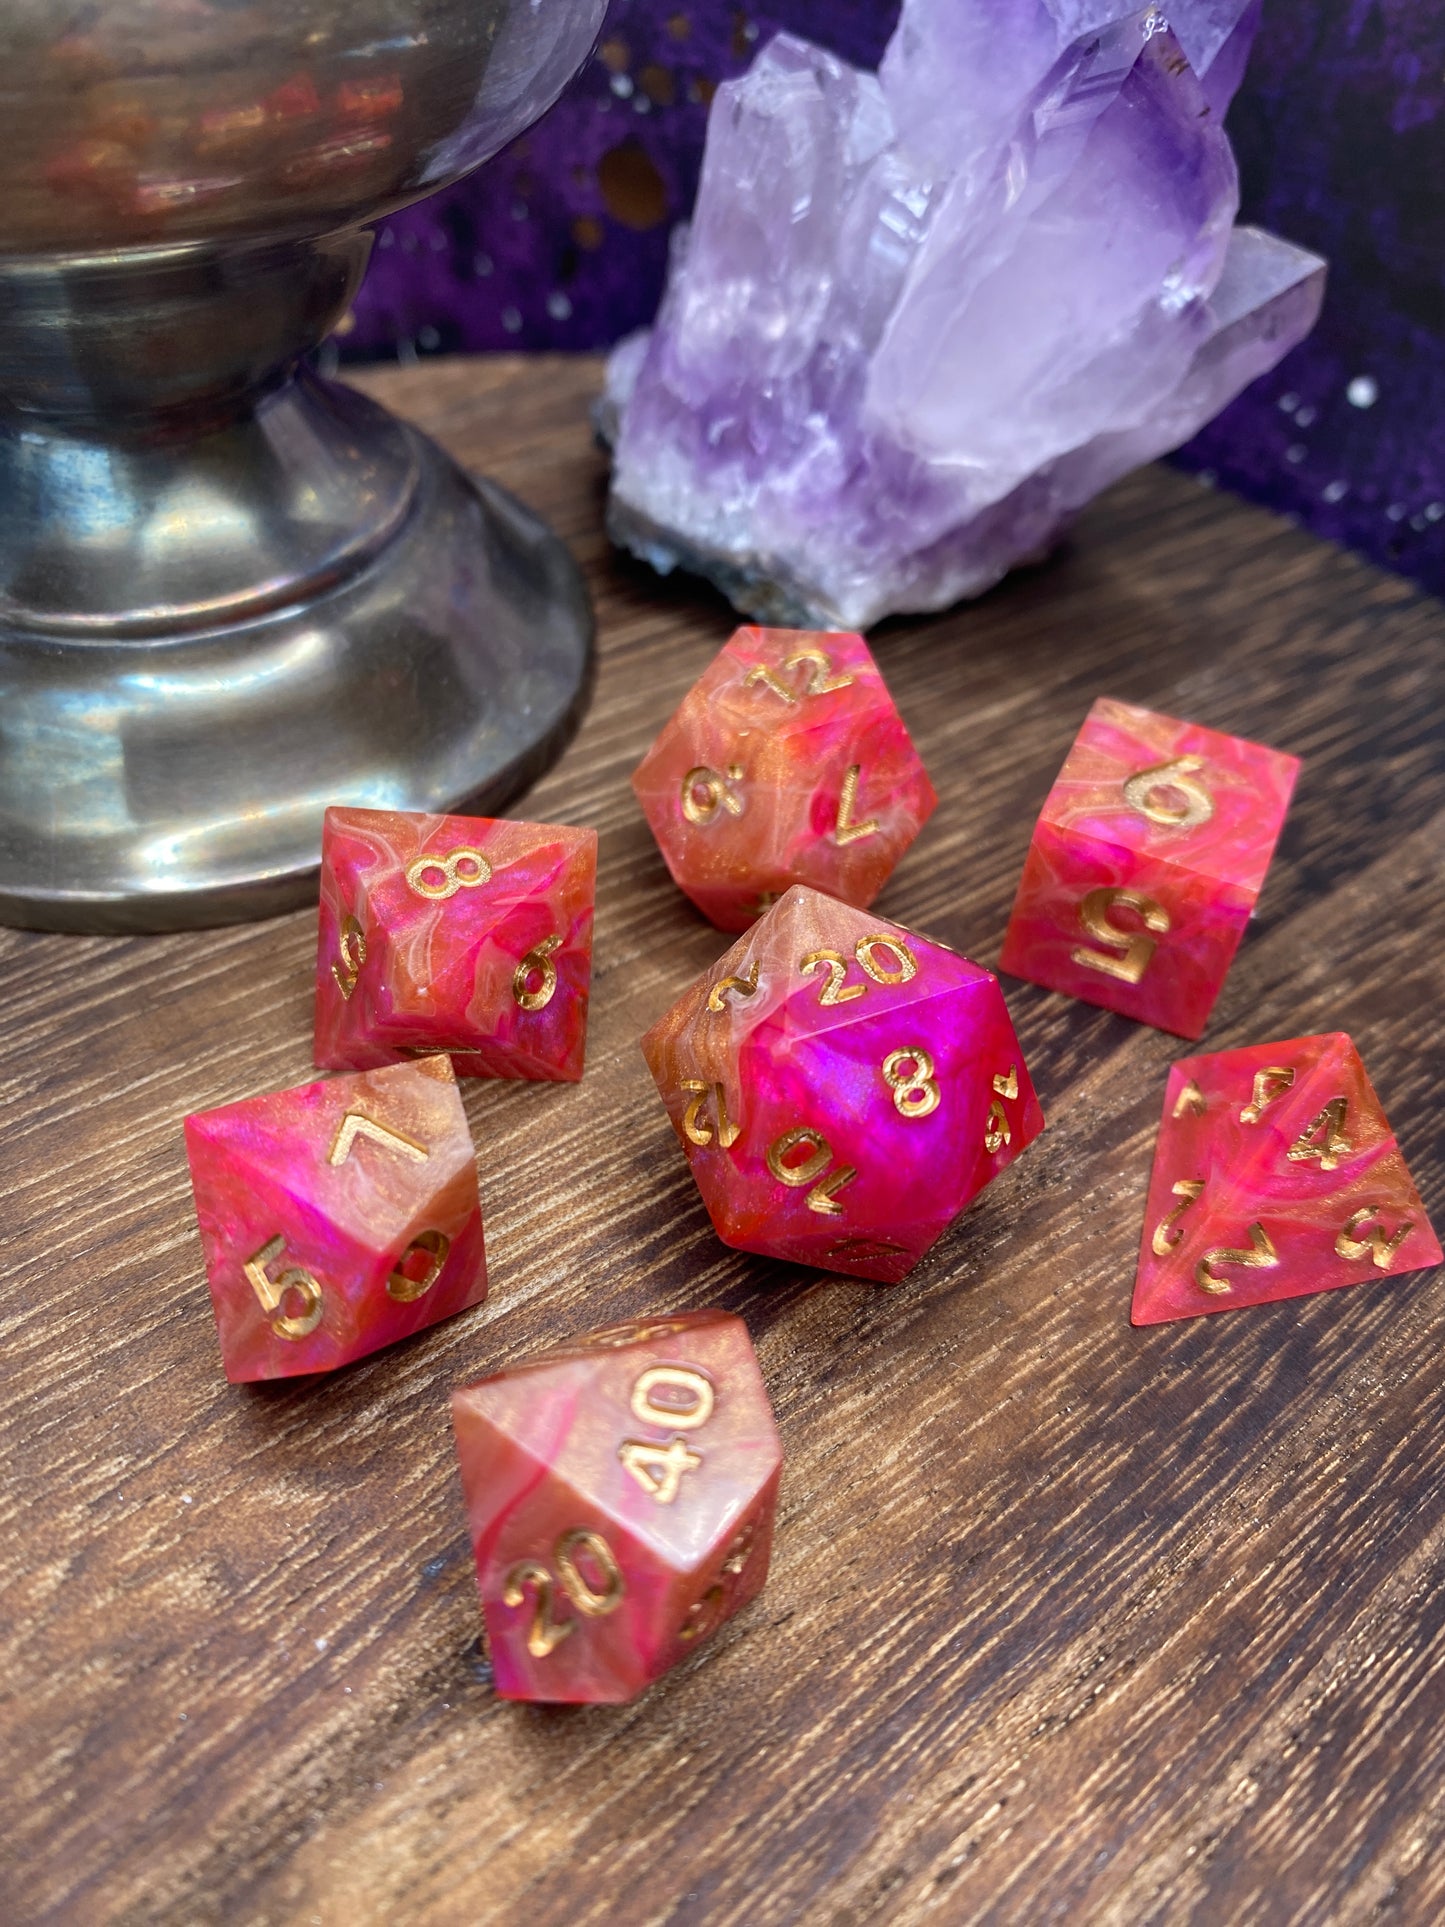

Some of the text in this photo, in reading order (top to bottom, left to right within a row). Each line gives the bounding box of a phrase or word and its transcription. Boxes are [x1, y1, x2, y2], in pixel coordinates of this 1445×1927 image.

[743, 648, 857, 704] 12
[835, 764, 881, 846] 7
[1123, 754, 1215, 828] 6
[404, 845, 493, 901] 8
[511, 933, 564, 1011] 6
[799, 932, 919, 1007] 20
[1070, 886, 1171, 985] 5
[706, 958, 761, 1013] 2
[679, 1078, 742, 1149] 12
[882, 1045, 941, 1119] 8
[328, 1111, 430, 1167] 7
[766, 1125, 859, 1216] 10
[1286, 1097, 1352, 1171] 4
[1152, 1179, 1206, 1256] 2
[1334, 1204, 1415, 1271] 3
[242, 1233, 325, 1342] 5
[385, 1229, 451, 1303] 0
[1195, 1221, 1280, 1295] 2
[617, 1358, 717, 1505] 40
[503, 1526, 626, 1659] 20
